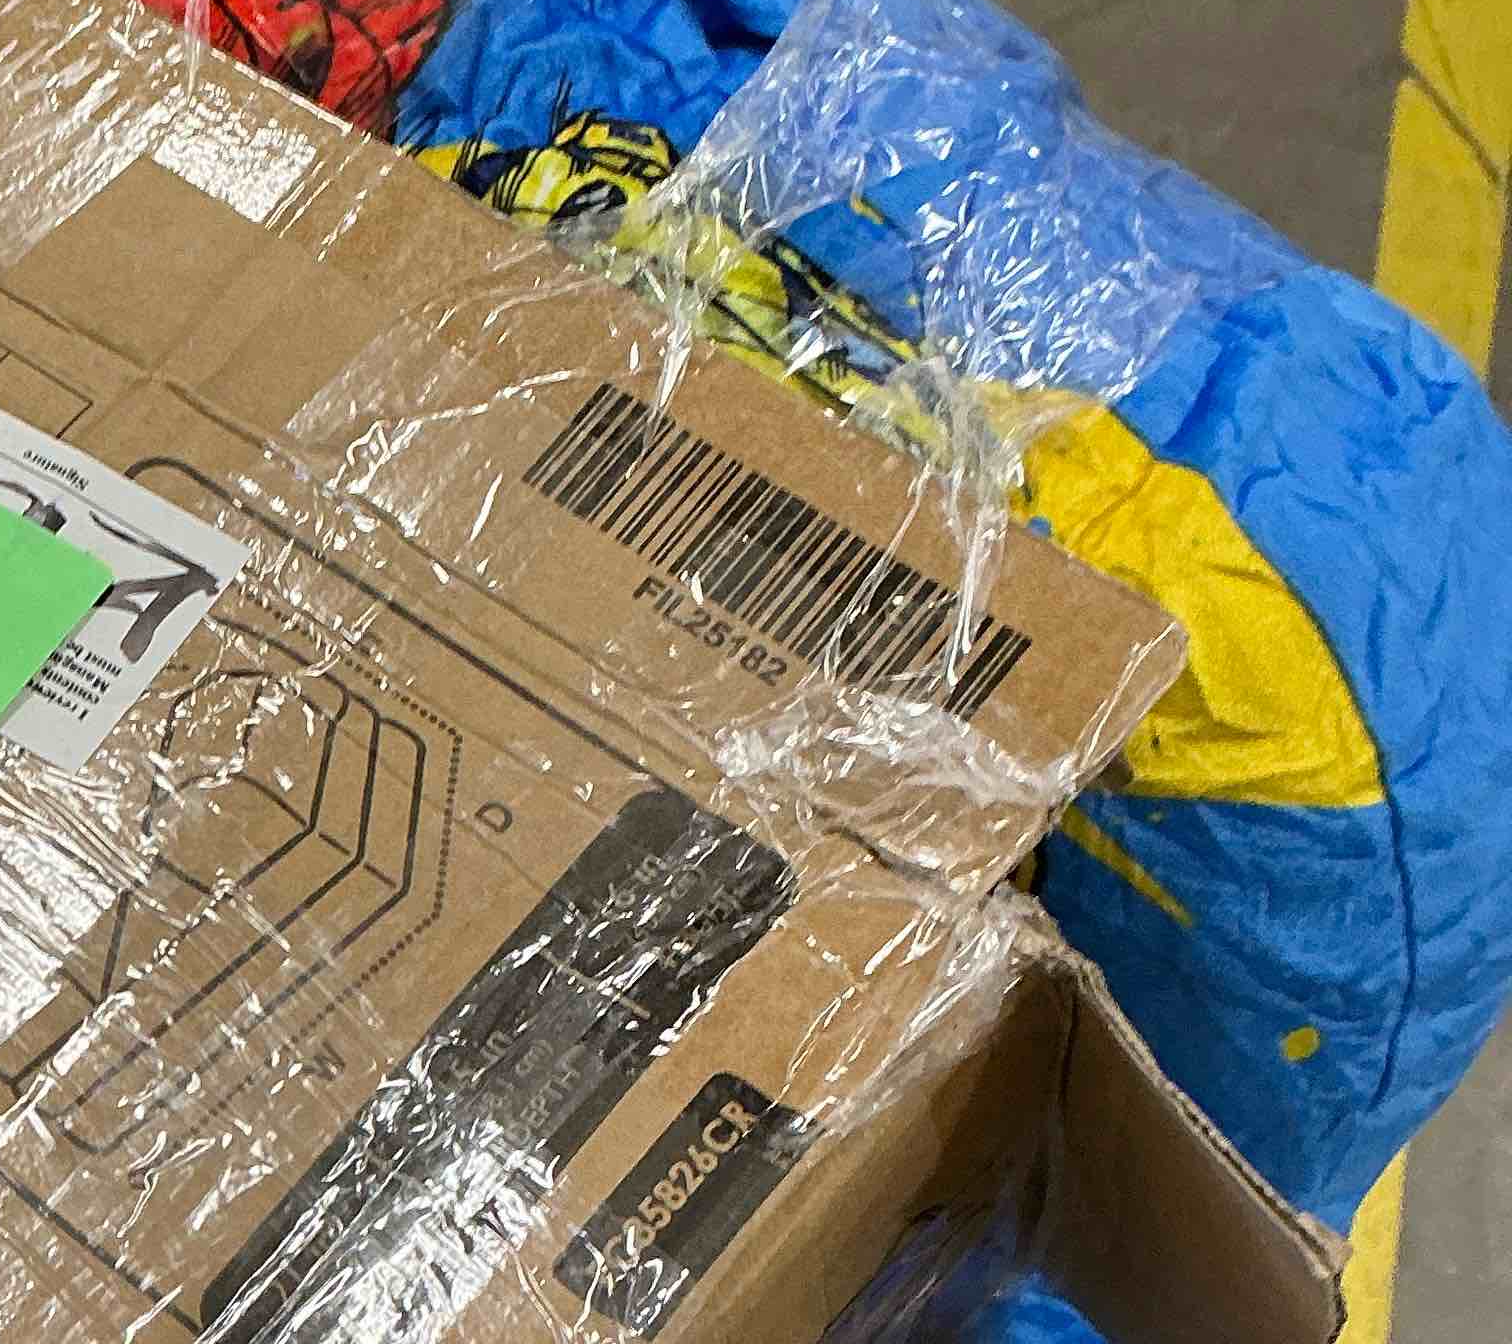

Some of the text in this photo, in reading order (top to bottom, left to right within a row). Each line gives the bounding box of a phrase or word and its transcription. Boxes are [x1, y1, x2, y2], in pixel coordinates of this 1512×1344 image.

[23, 450, 89, 492] Signature
[629, 572, 791, 689] FIL25182
[83, 651, 122, 677] must
